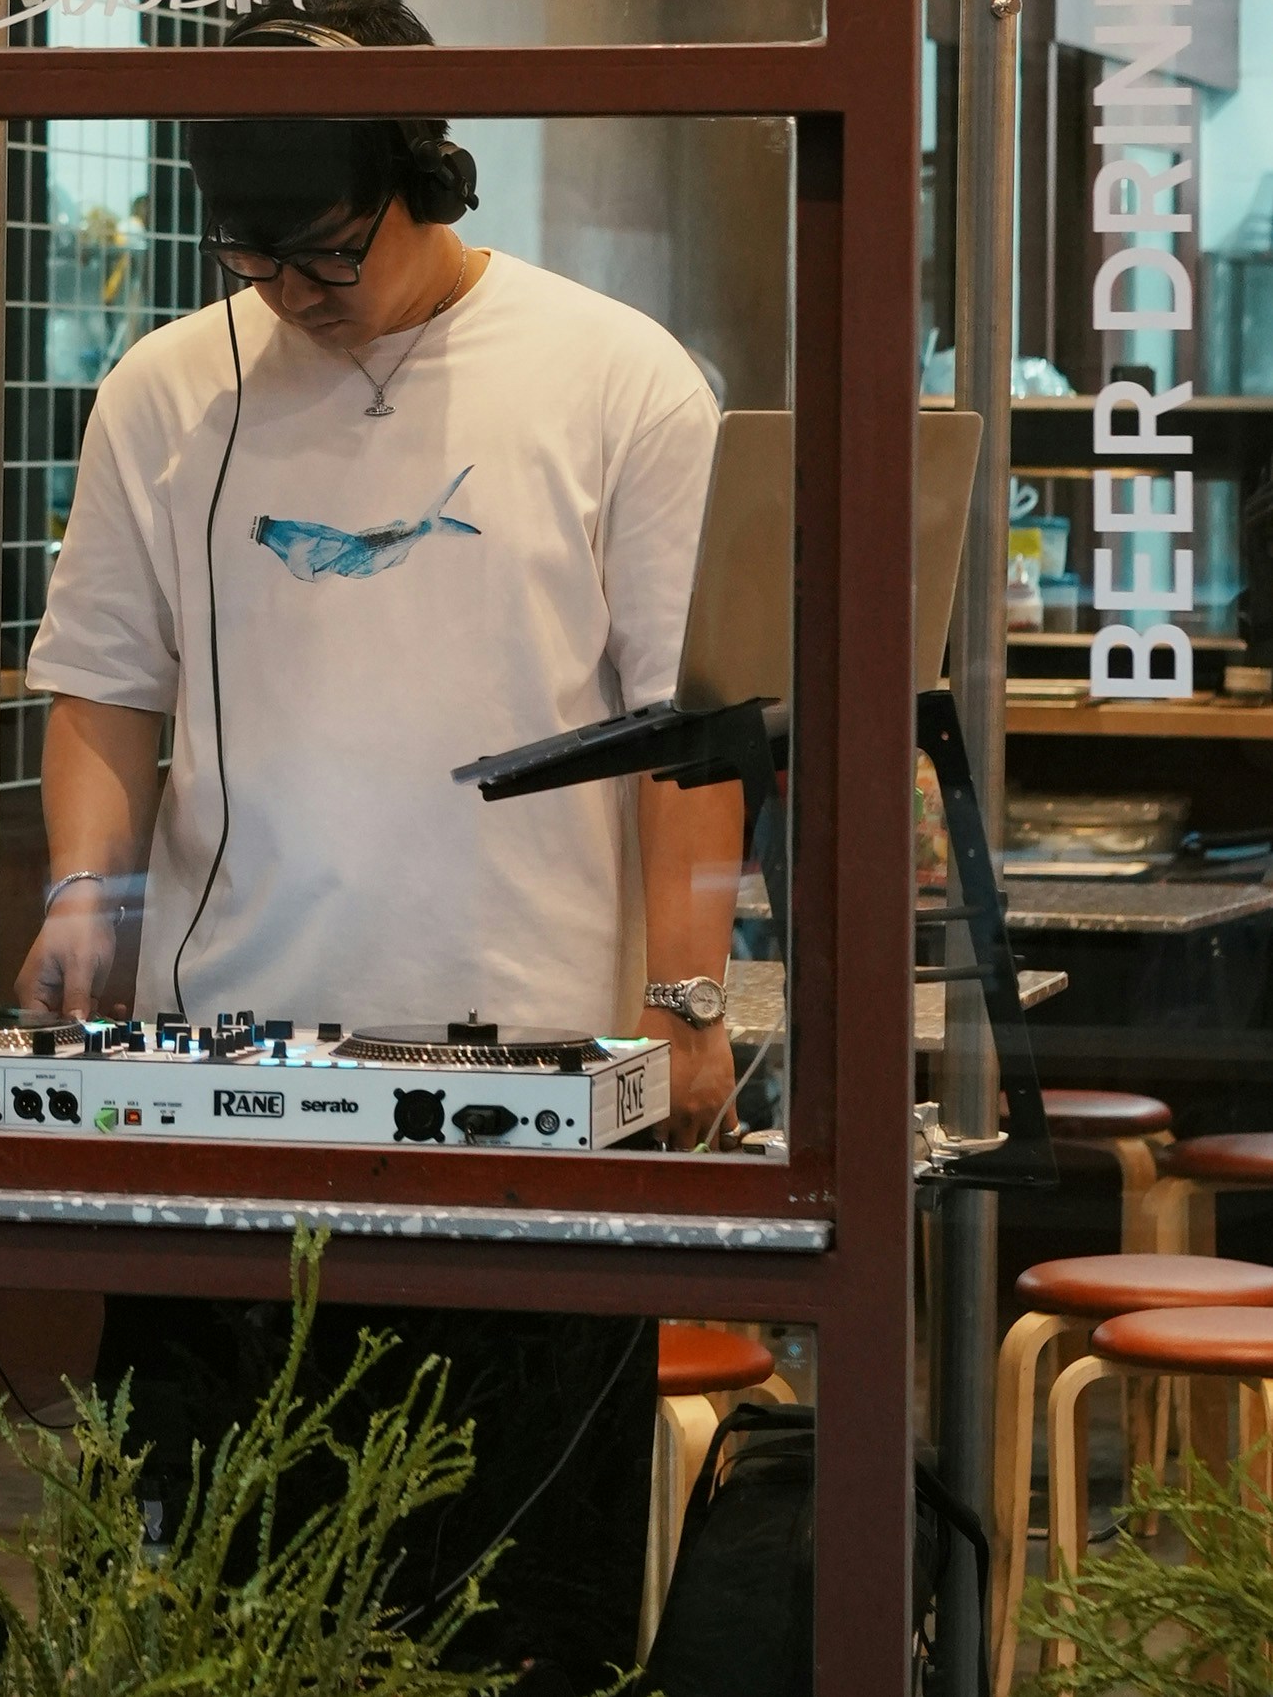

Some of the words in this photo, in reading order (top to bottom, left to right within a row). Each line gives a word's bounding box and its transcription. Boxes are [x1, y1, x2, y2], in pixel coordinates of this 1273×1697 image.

[1090, 380, 1194, 699] BEER
[213, 1090, 285, 1118] RANE
[300, 1099, 359, 1114] serato
